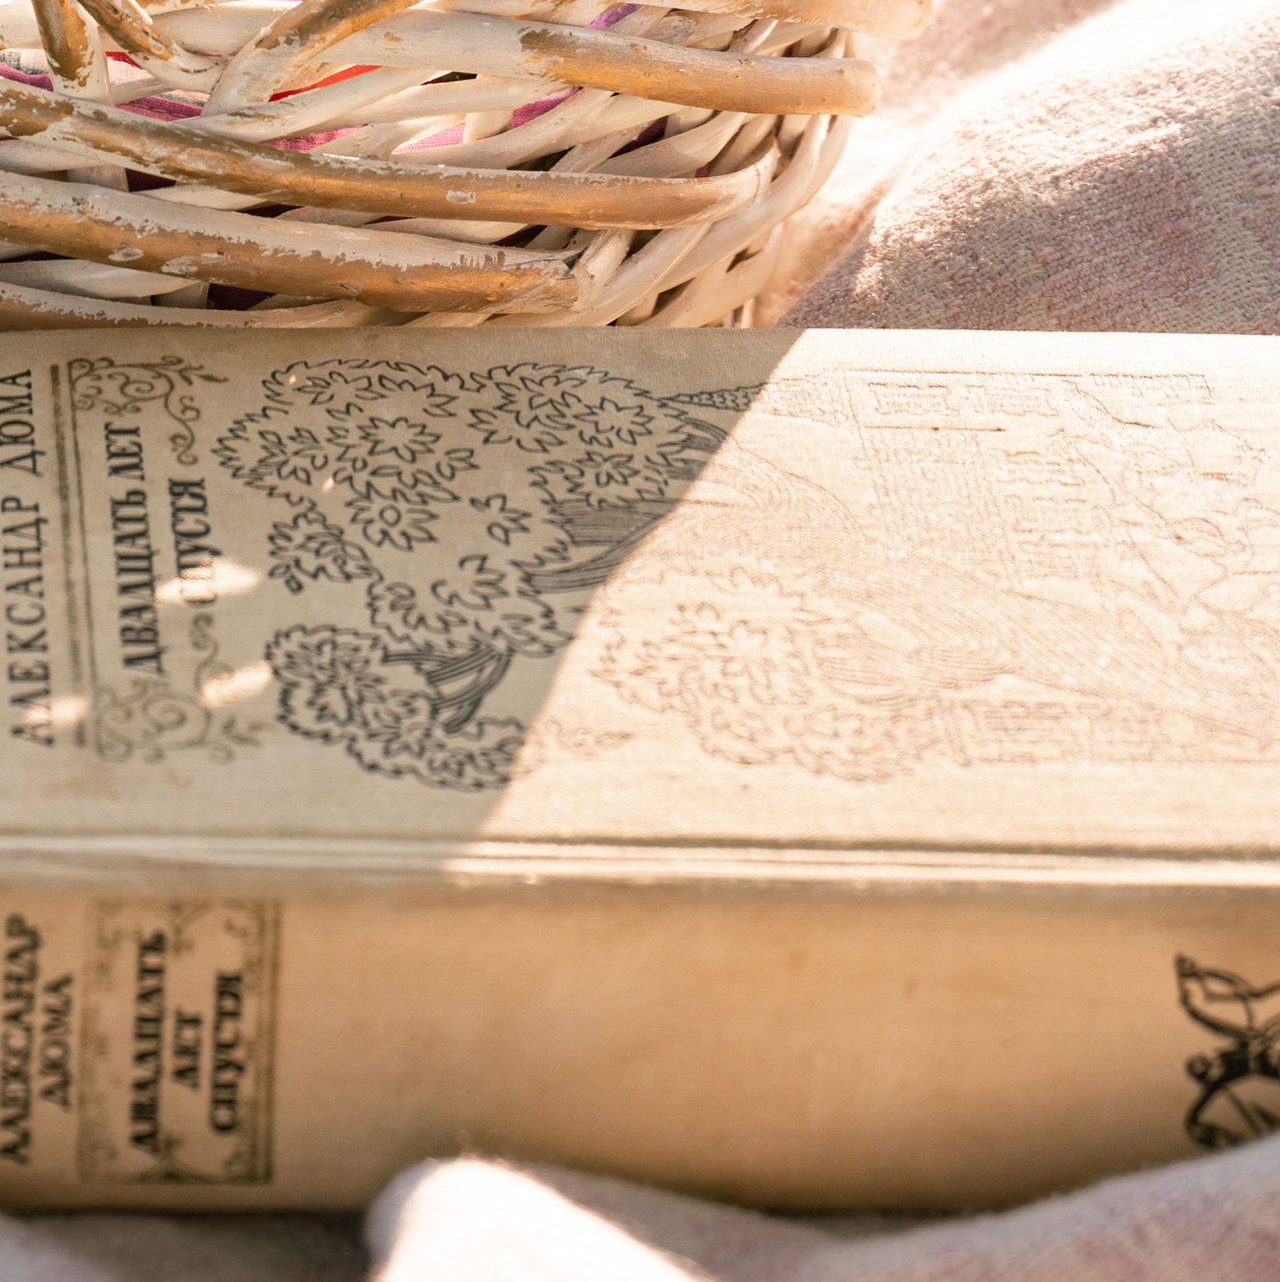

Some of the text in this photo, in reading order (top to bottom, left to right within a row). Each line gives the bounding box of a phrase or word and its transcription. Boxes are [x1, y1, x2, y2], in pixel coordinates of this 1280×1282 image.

[1, 496, 54, 747] АЛЕКСАНДР
[104, 421, 169, 677] ДВАДЦАТЬ ЛЕТ
[168, 476, 222, 608] СПУСТЯ
[39, 969, 73, 1115] ДЮМА
[129, 929, 167, 1156] ДВАДЦАТЬ
[172, 1006, 203, 1093] ЛЕТ
[210, 972, 245, 1137] СПУСТЯ
